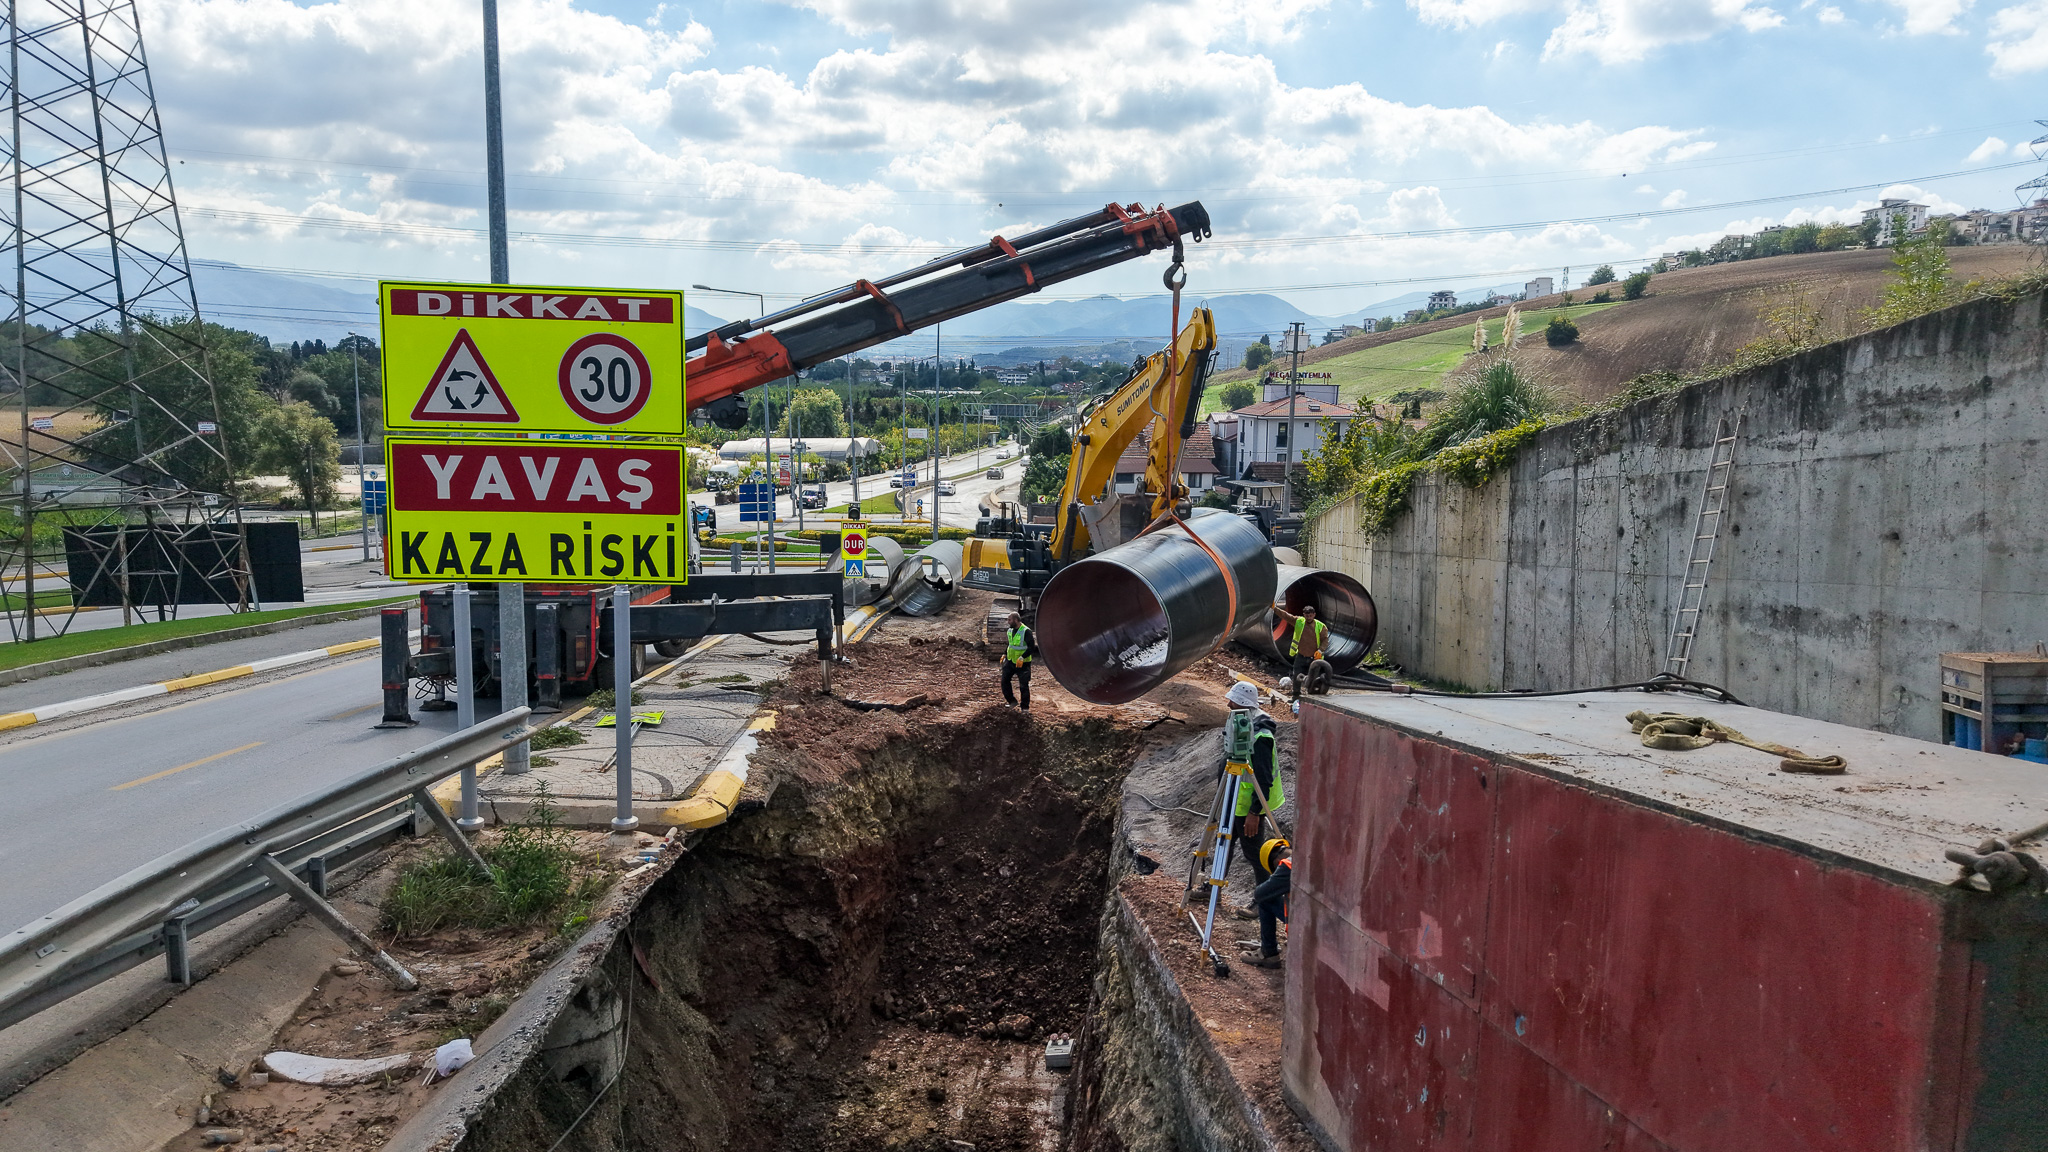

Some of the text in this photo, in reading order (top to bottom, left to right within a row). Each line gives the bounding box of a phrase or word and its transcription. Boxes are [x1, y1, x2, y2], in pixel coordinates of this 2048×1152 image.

[417, 292, 650, 321] DİKKAT
[580, 356, 632, 403] 30
[1116, 378, 1150, 416] SUMITOMO
[421, 454, 654, 510] YAVAŞ
[401, 521, 676, 578] KAZA RİSKİ
[844, 539, 864, 549] DUR
